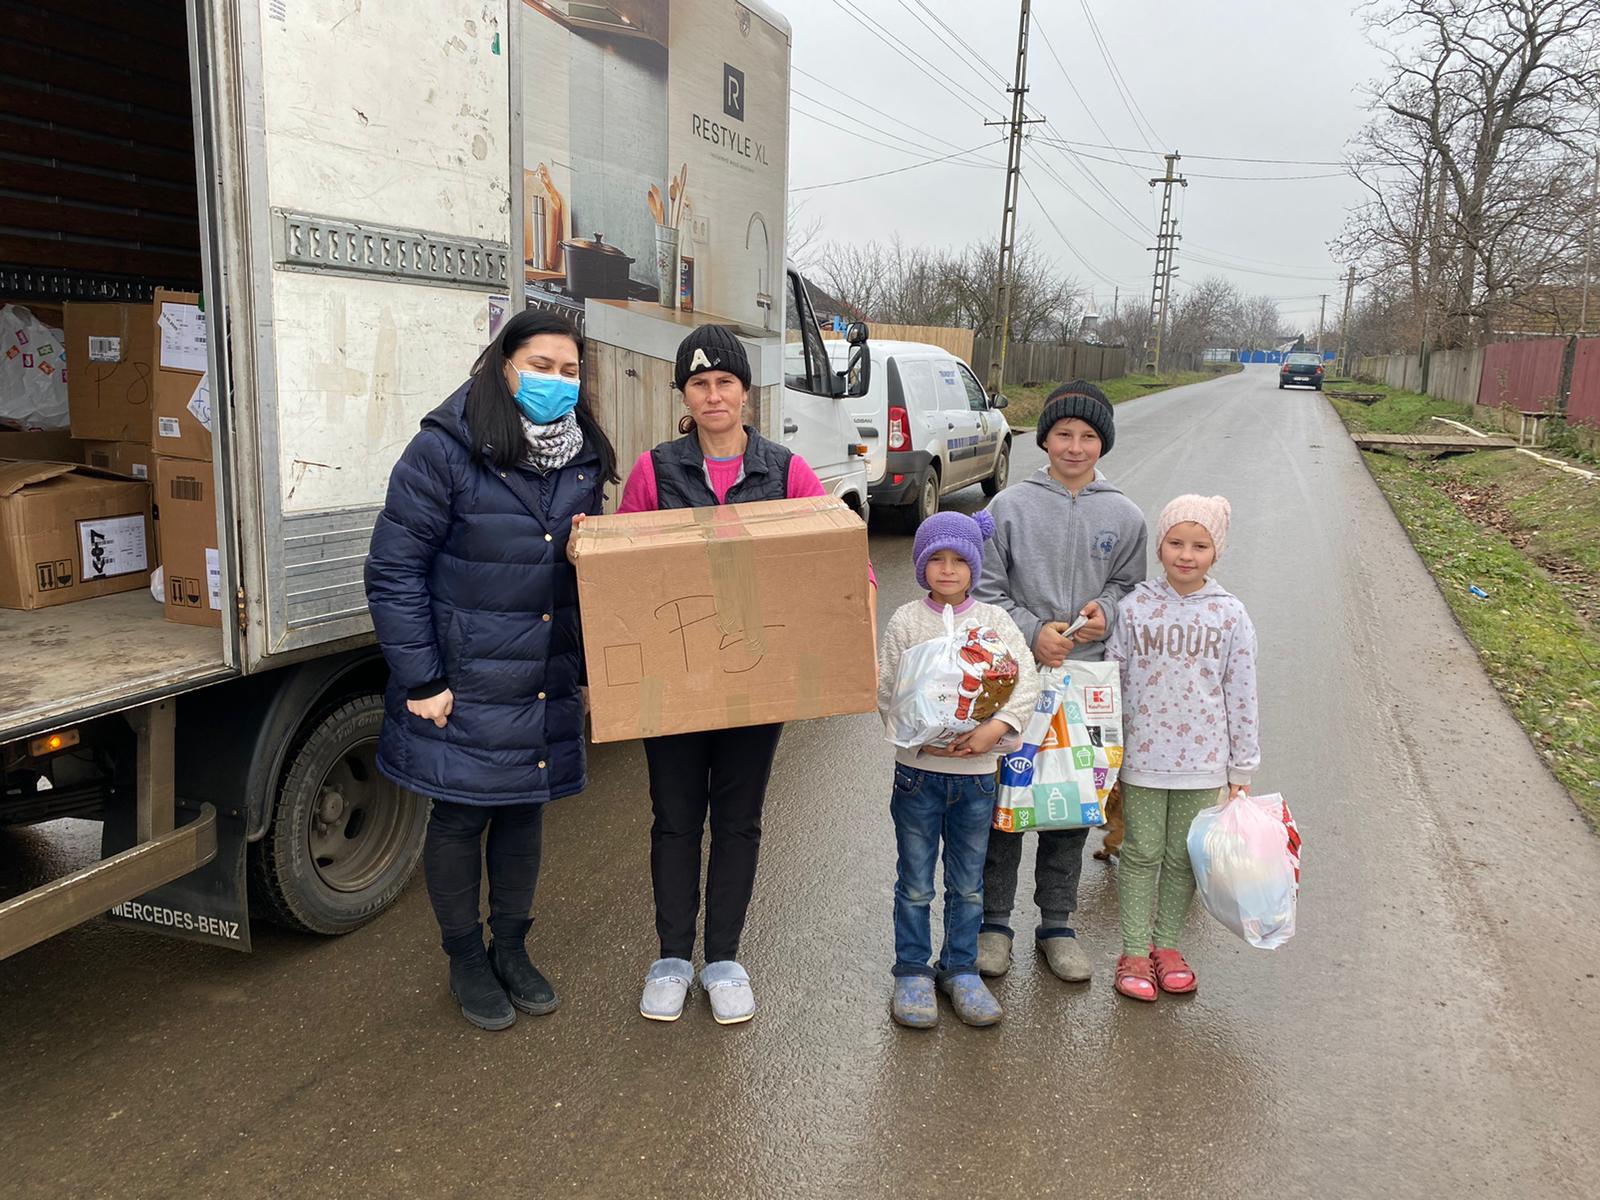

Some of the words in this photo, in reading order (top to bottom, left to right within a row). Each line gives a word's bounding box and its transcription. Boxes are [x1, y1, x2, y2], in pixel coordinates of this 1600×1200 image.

[728, 75, 740, 110] R
[692, 113, 751, 158] RESTYLE
[754, 142, 769, 166] XL
[690, 348, 712, 371] A
[112, 901, 240, 939] MERCEDES-BENZ
